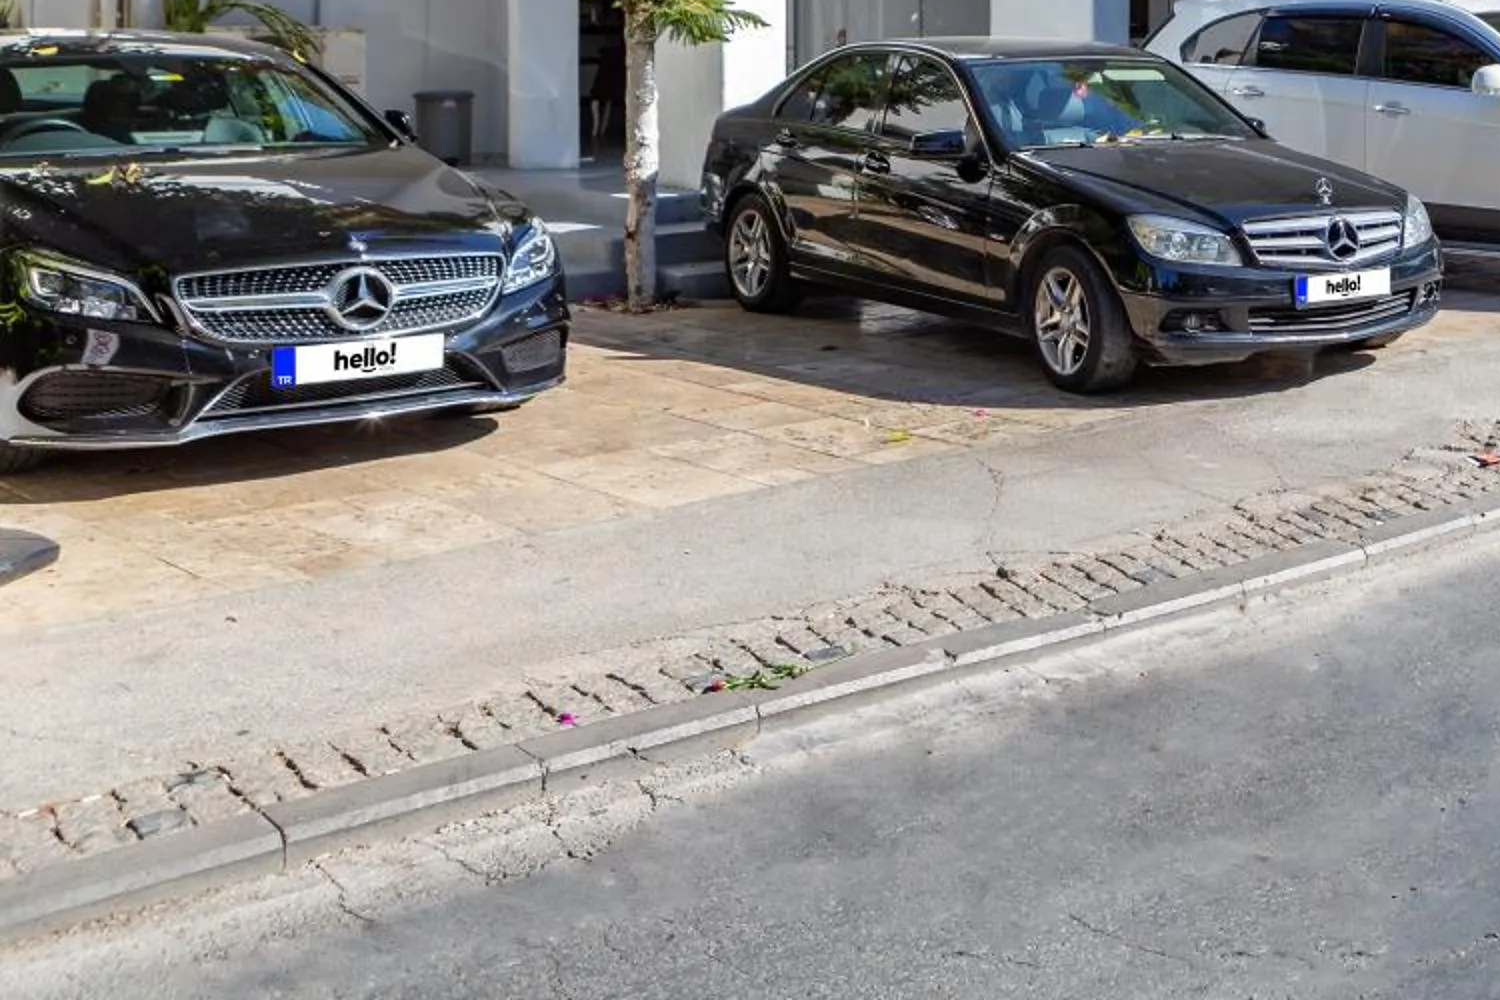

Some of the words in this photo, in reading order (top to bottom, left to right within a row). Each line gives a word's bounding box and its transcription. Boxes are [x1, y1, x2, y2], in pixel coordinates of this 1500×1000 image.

[1326, 275, 1361, 295] hello!
[334, 343, 397, 372] hello!
[278, 375, 292, 385] TR
